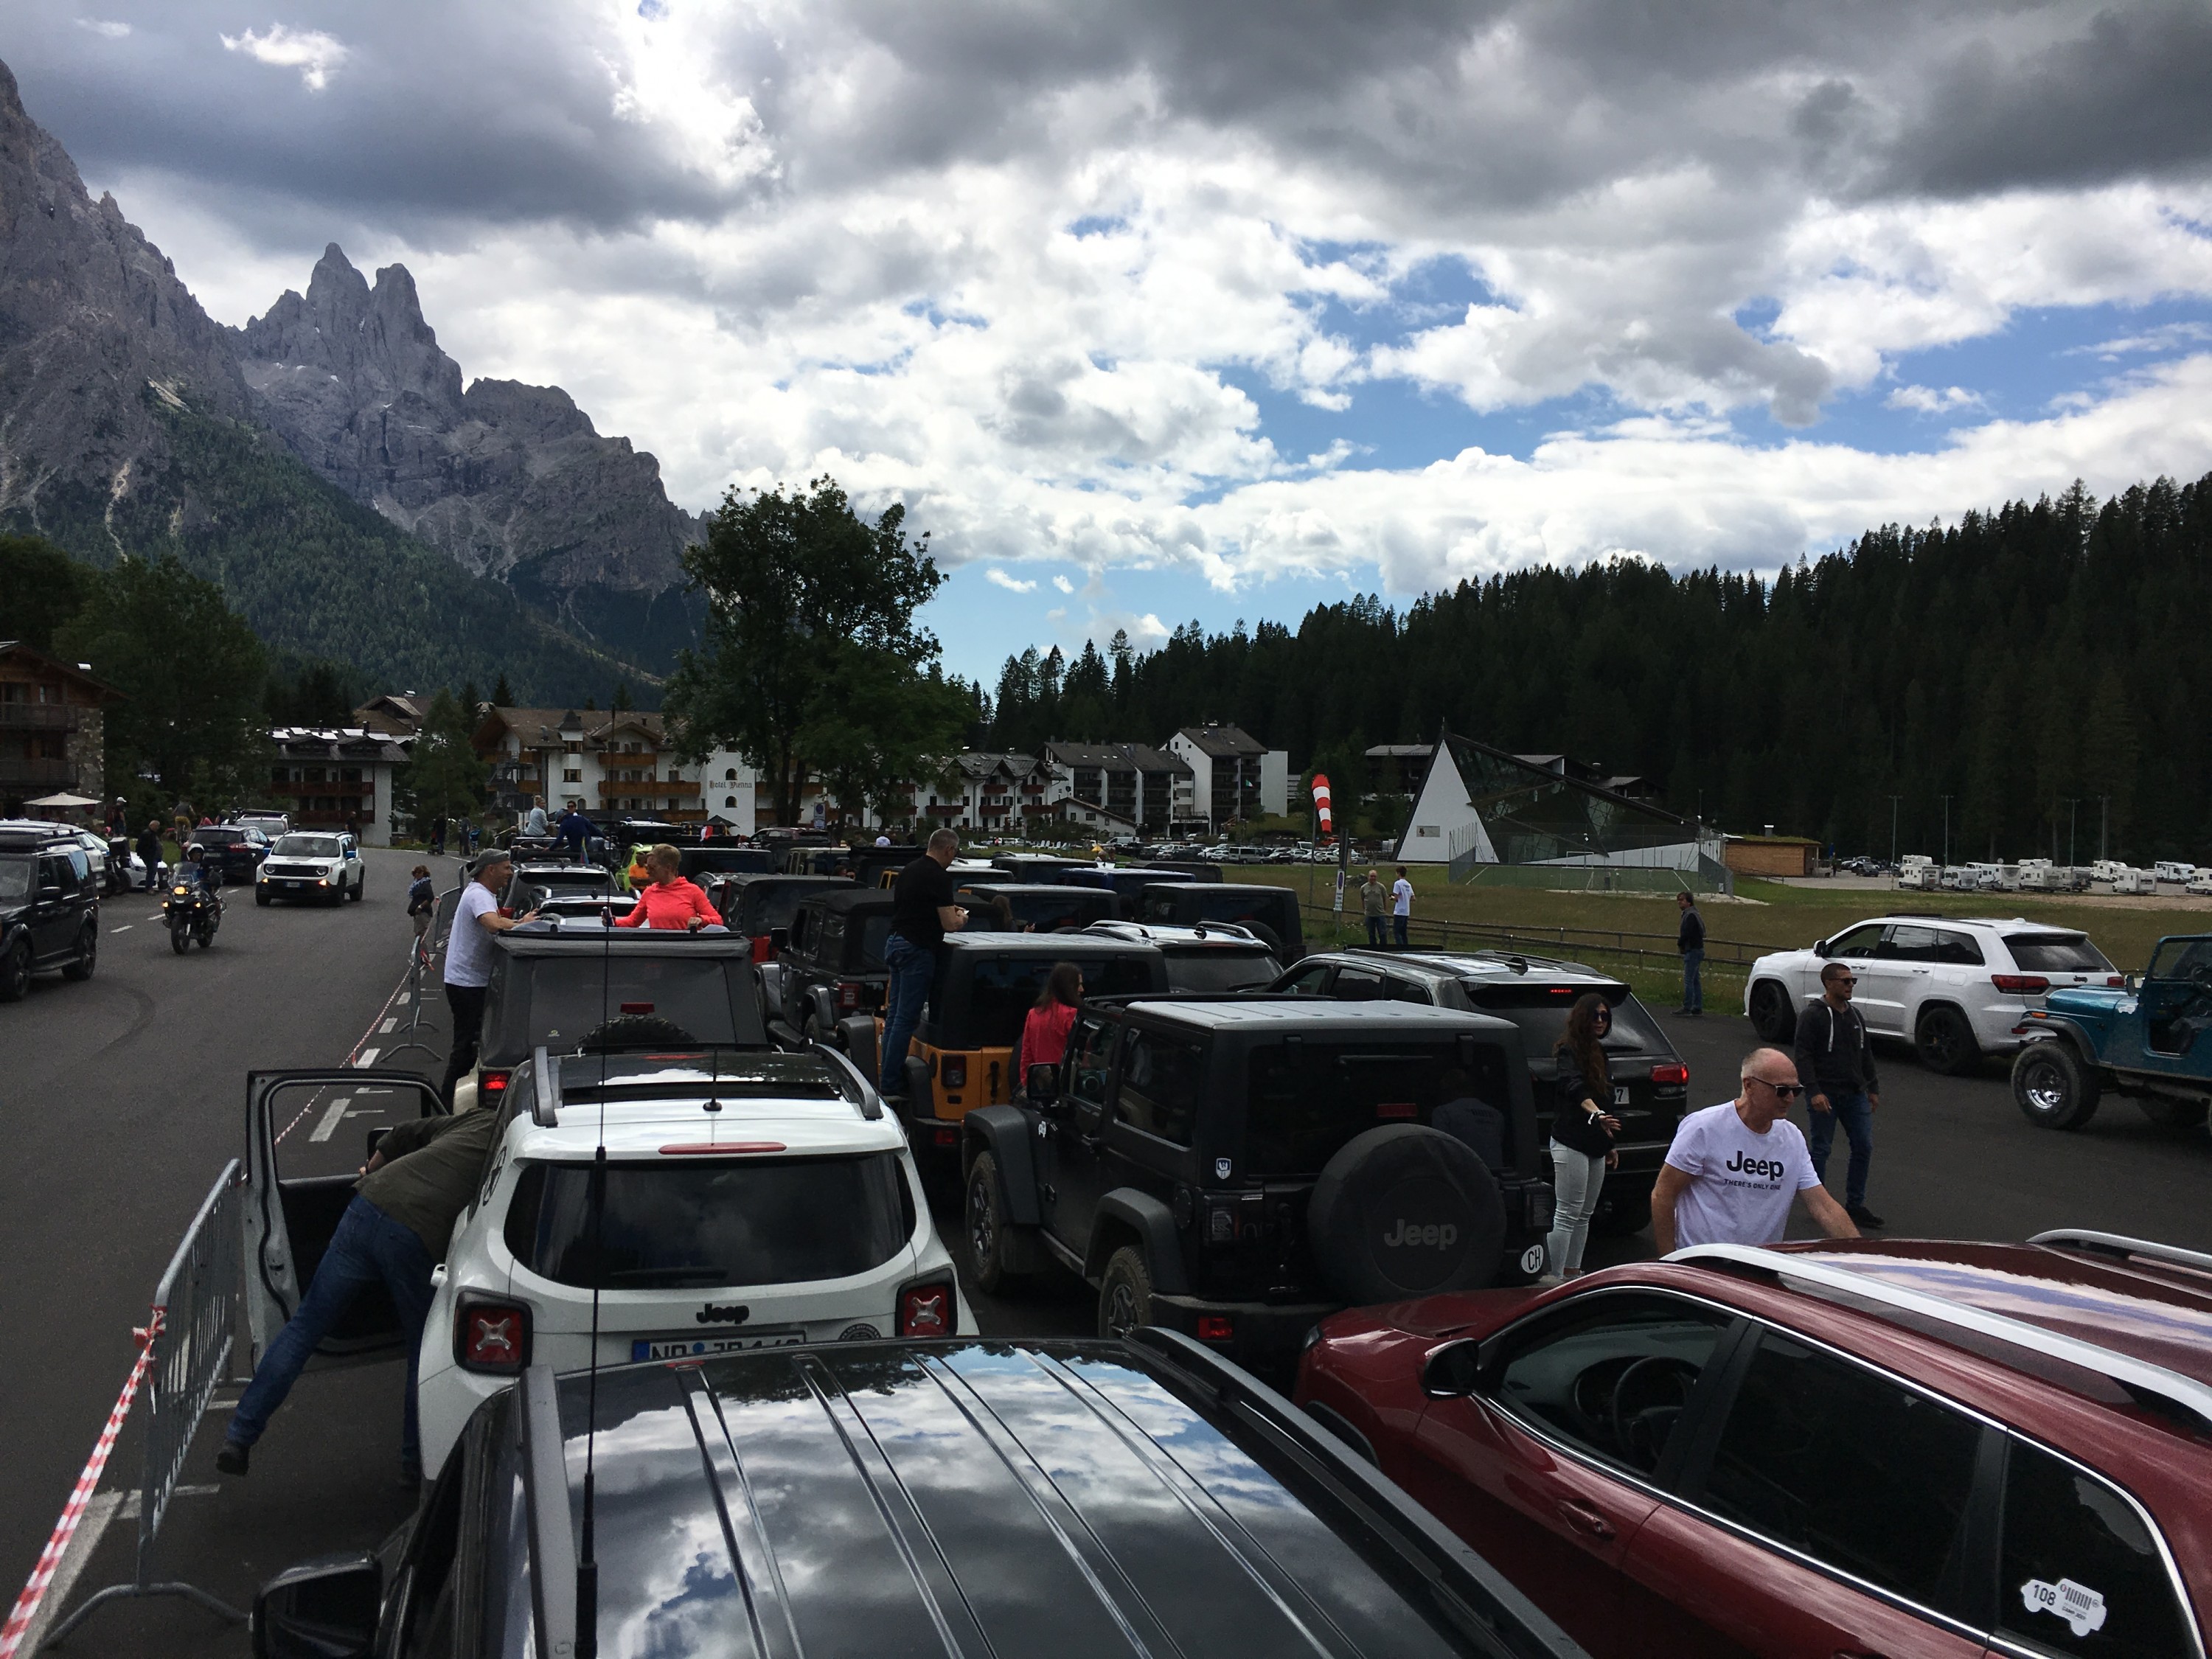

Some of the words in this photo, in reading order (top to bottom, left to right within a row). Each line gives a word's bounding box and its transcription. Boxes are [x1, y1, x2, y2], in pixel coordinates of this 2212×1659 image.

[1726, 1150, 1784, 1181] Jeep
[1724, 1178, 1752, 1188] THERE'S
[1384, 1218, 1458, 1251] Jeep
[1528, 1247, 1541, 1270] CH
[696, 1303, 750, 1324] Jeep
[2034, 1584, 2056, 1606] 108
